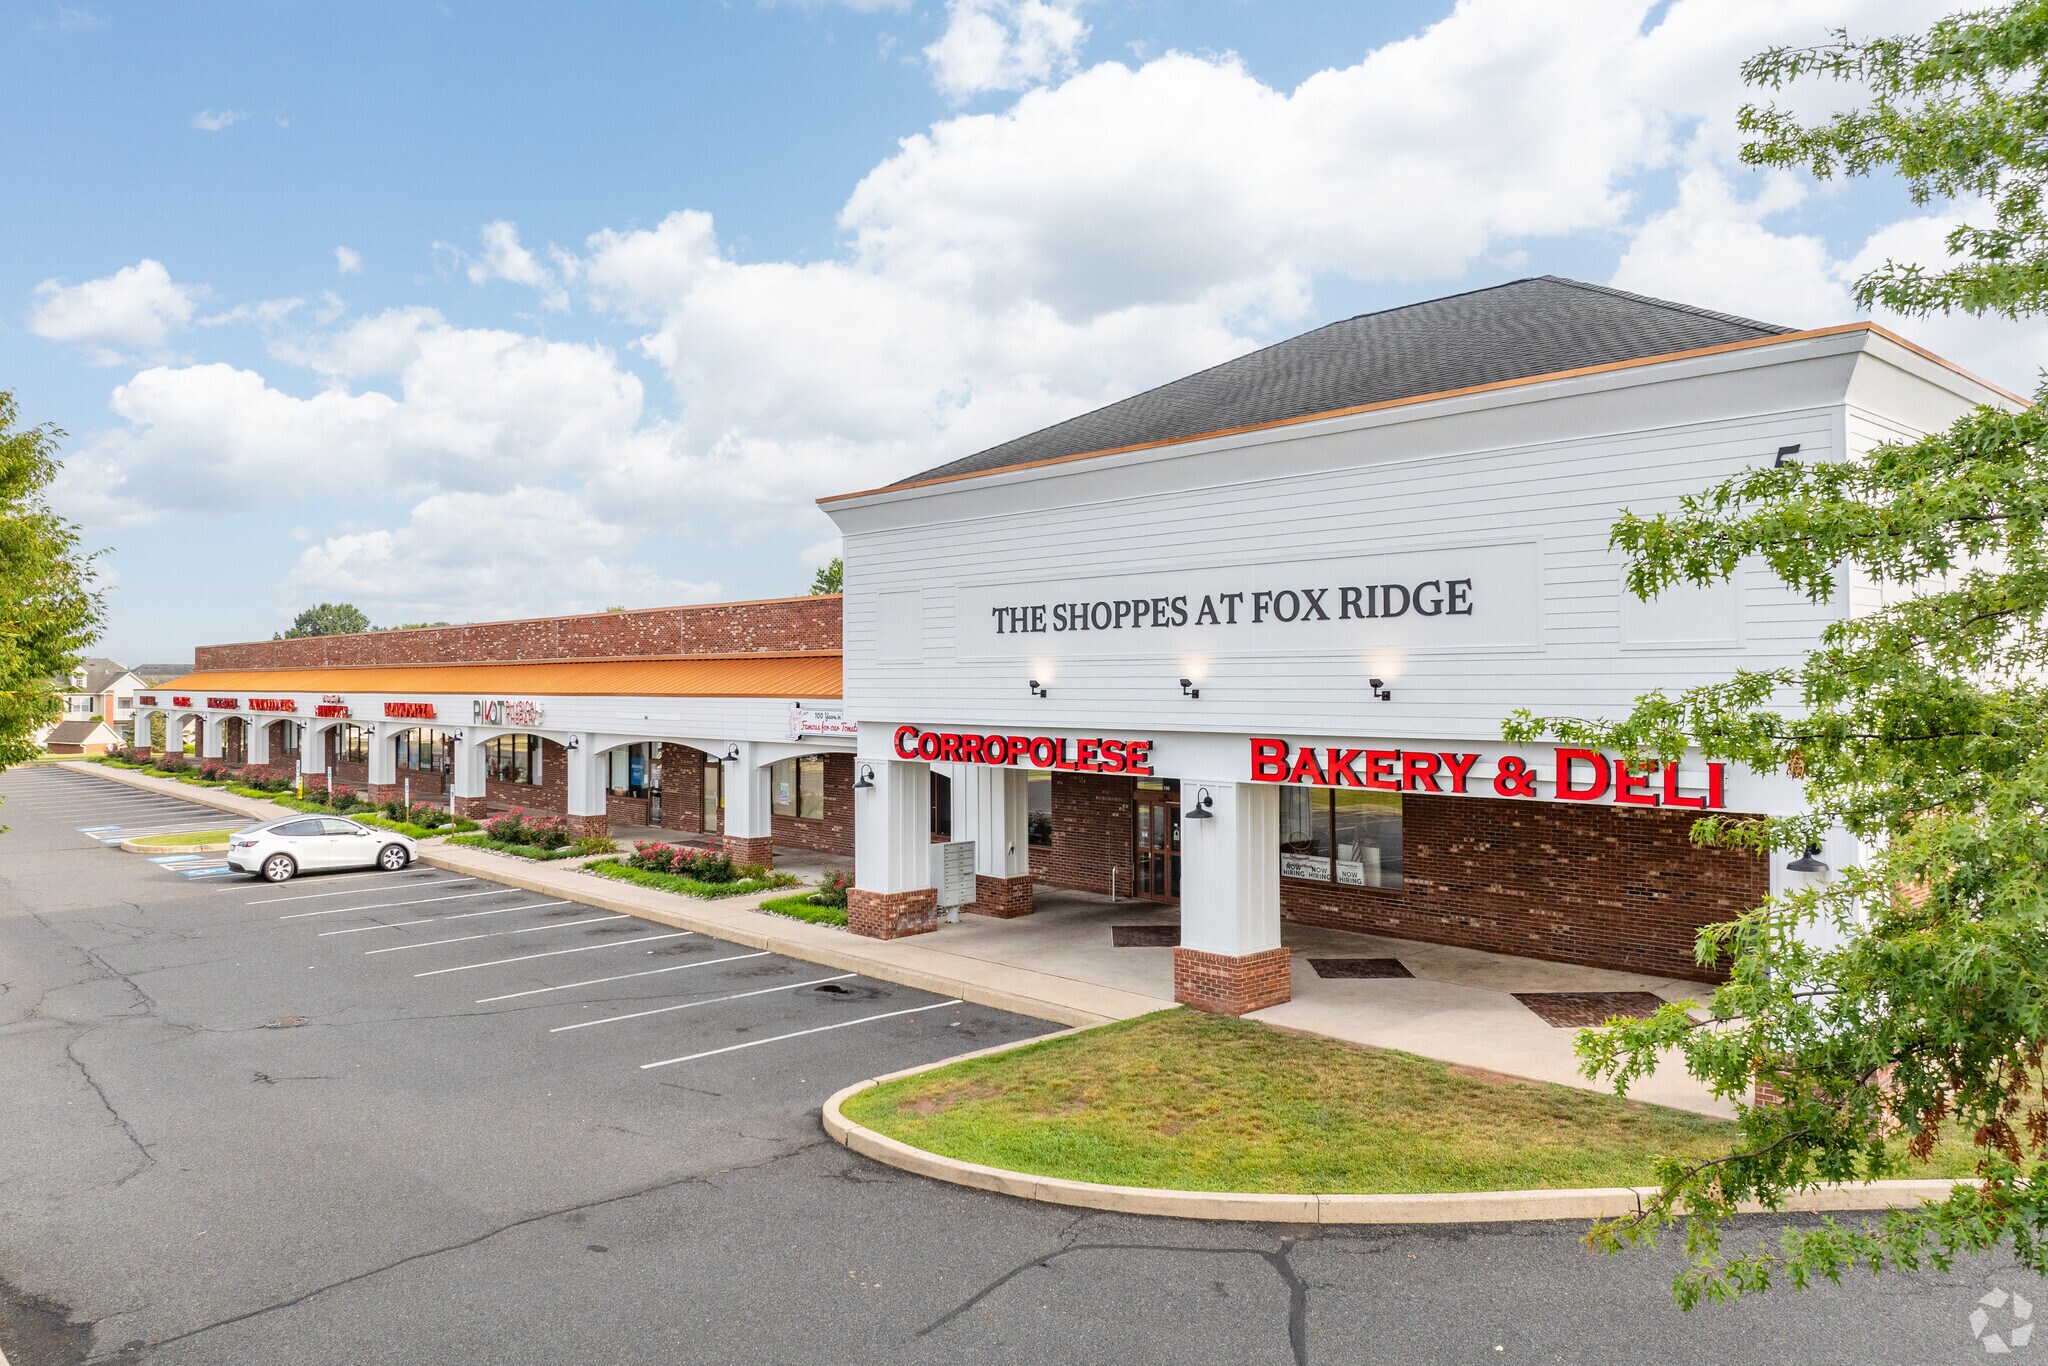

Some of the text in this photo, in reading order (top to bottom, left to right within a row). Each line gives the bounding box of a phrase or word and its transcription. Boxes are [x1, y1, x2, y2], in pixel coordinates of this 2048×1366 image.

[992, 578, 1473, 634] THE SHOPPES AT FOX RIDGE
[473, 700, 504, 725] PIVOT
[506, 700, 538, 713] PHYSICAL
[506, 713, 537, 725] THERAPY
[801, 720, 820, 731] Famous
[821, 720, 829, 734] for
[894, 725, 1154, 776] CORROPOLESE
[1250, 738, 1727, 809] BAKERY & DELI
[1283, 869, 1305, 878] HIRING
[1309, 872, 1330, 881] HIRING
[1311, 866, 1328, 874] NOW
[1339, 877, 1362, 885] HIRING
